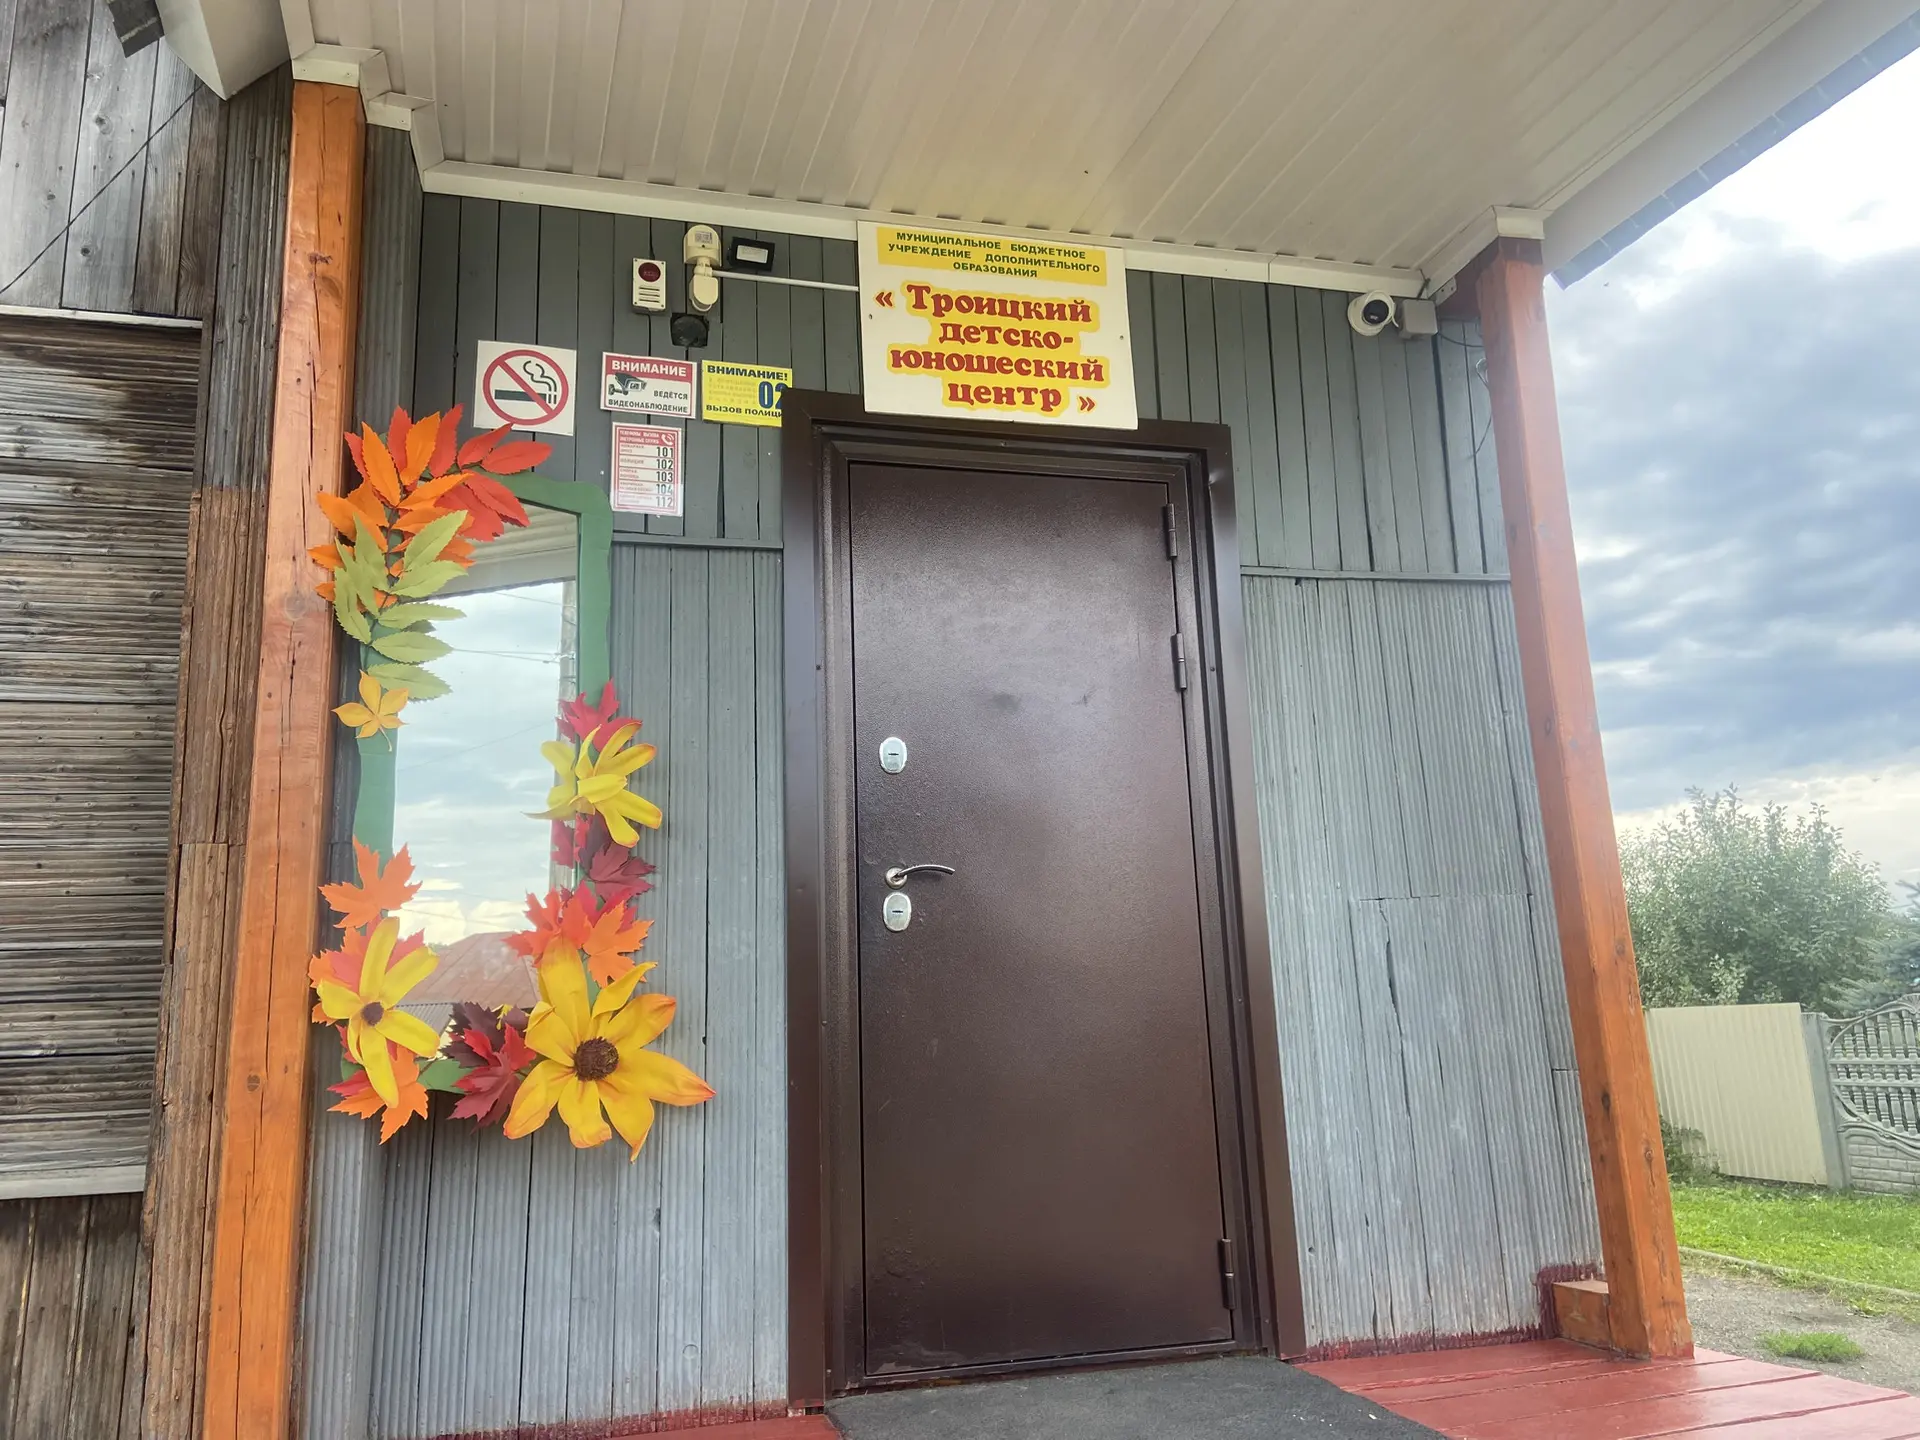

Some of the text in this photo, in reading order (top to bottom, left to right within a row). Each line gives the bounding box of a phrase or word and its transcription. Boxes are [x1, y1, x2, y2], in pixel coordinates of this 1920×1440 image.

[896, 232, 1086, 259] МУНИЦИПАЛЬНОЕ БЮДЖЕТНОЕ
[888, 243, 1100, 273] УЧРЕЖДЕНИЕ ДОПОЛНИТЕЛЬНОГО
[953, 262, 1038, 278] ОБРАЗОВАНИЯ
[907, 284, 1092, 322] Троицкий
[938, 322, 1074, 350] детско-
[611, 359, 687, 377] ВНИМАНИЕ
[707, 364, 788, 381] ВНИМАНИЕ!
[890, 349, 1104, 382] юношеский
[947, 382, 1062, 412] центр
[608, 398, 688, 413] ВИДЕОНАБЛЮДЕНИЕ
[706, 404, 742, 414] ВЫЗОВ
[656, 446, 674, 458] 101
[656, 459, 674, 471] 102
[656, 471, 673, 483] 103
[656, 484, 673, 495] 104
[656, 496, 673, 508] 112
